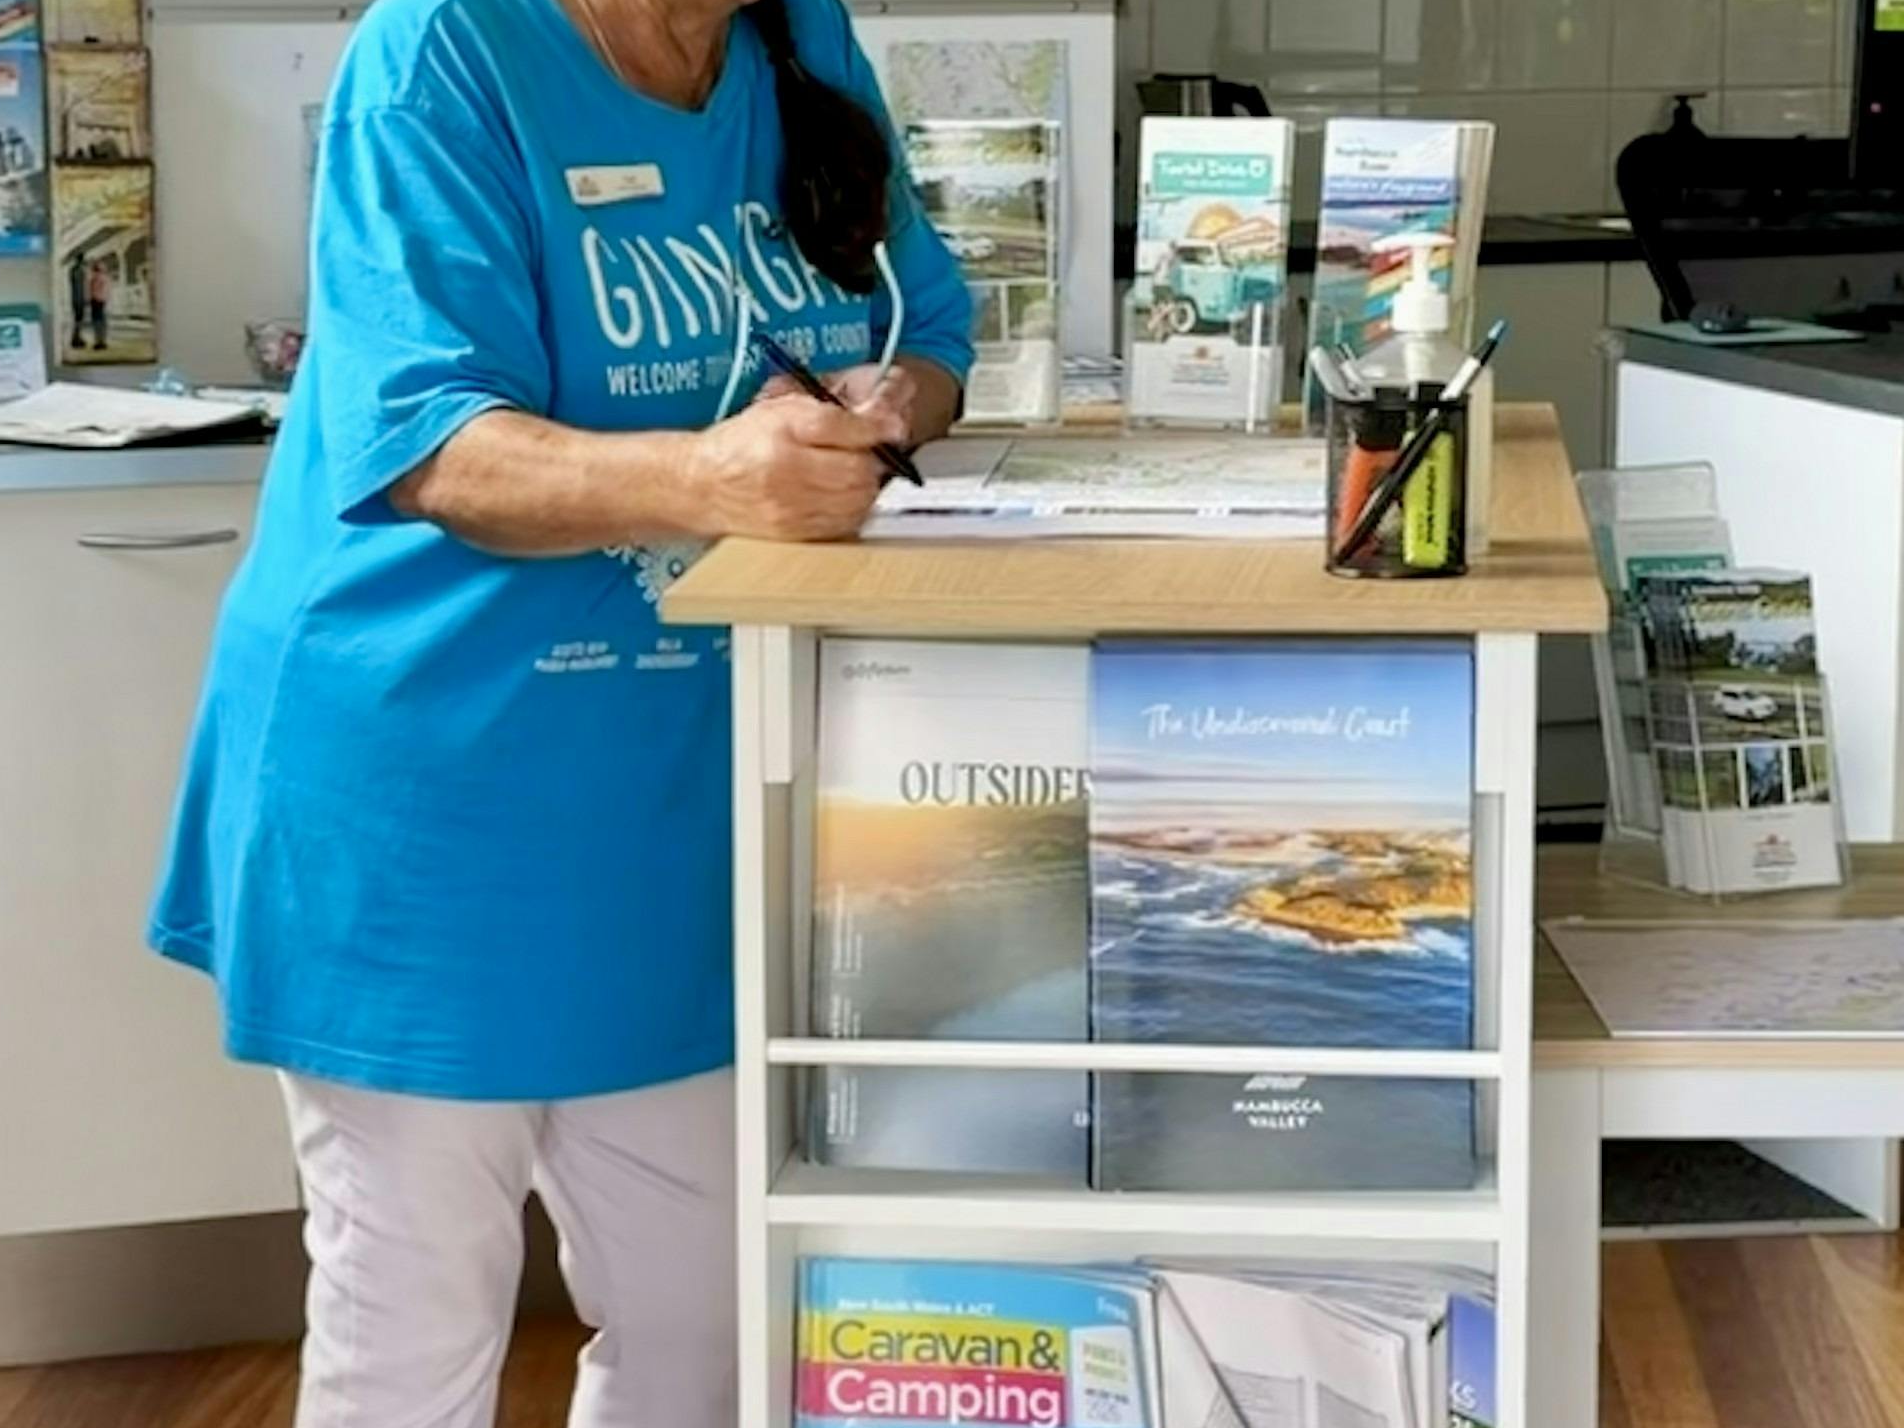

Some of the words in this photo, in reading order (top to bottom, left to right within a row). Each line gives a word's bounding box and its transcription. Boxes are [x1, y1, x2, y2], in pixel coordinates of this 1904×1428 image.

[606, 355, 701, 396] WELCOME
[1143, 702, 1186, 740] The
[1191, 704, 1337, 741] Undiscovered
[1342, 704, 1413, 740] Coast
[1231, 1097, 1325, 1116] NAMBUCCA
[1248, 1114, 1307, 1130] VALLEY
[829, 1319, 1022, 1369] Caravan
[1026, 1329, 1061, 1371] &
